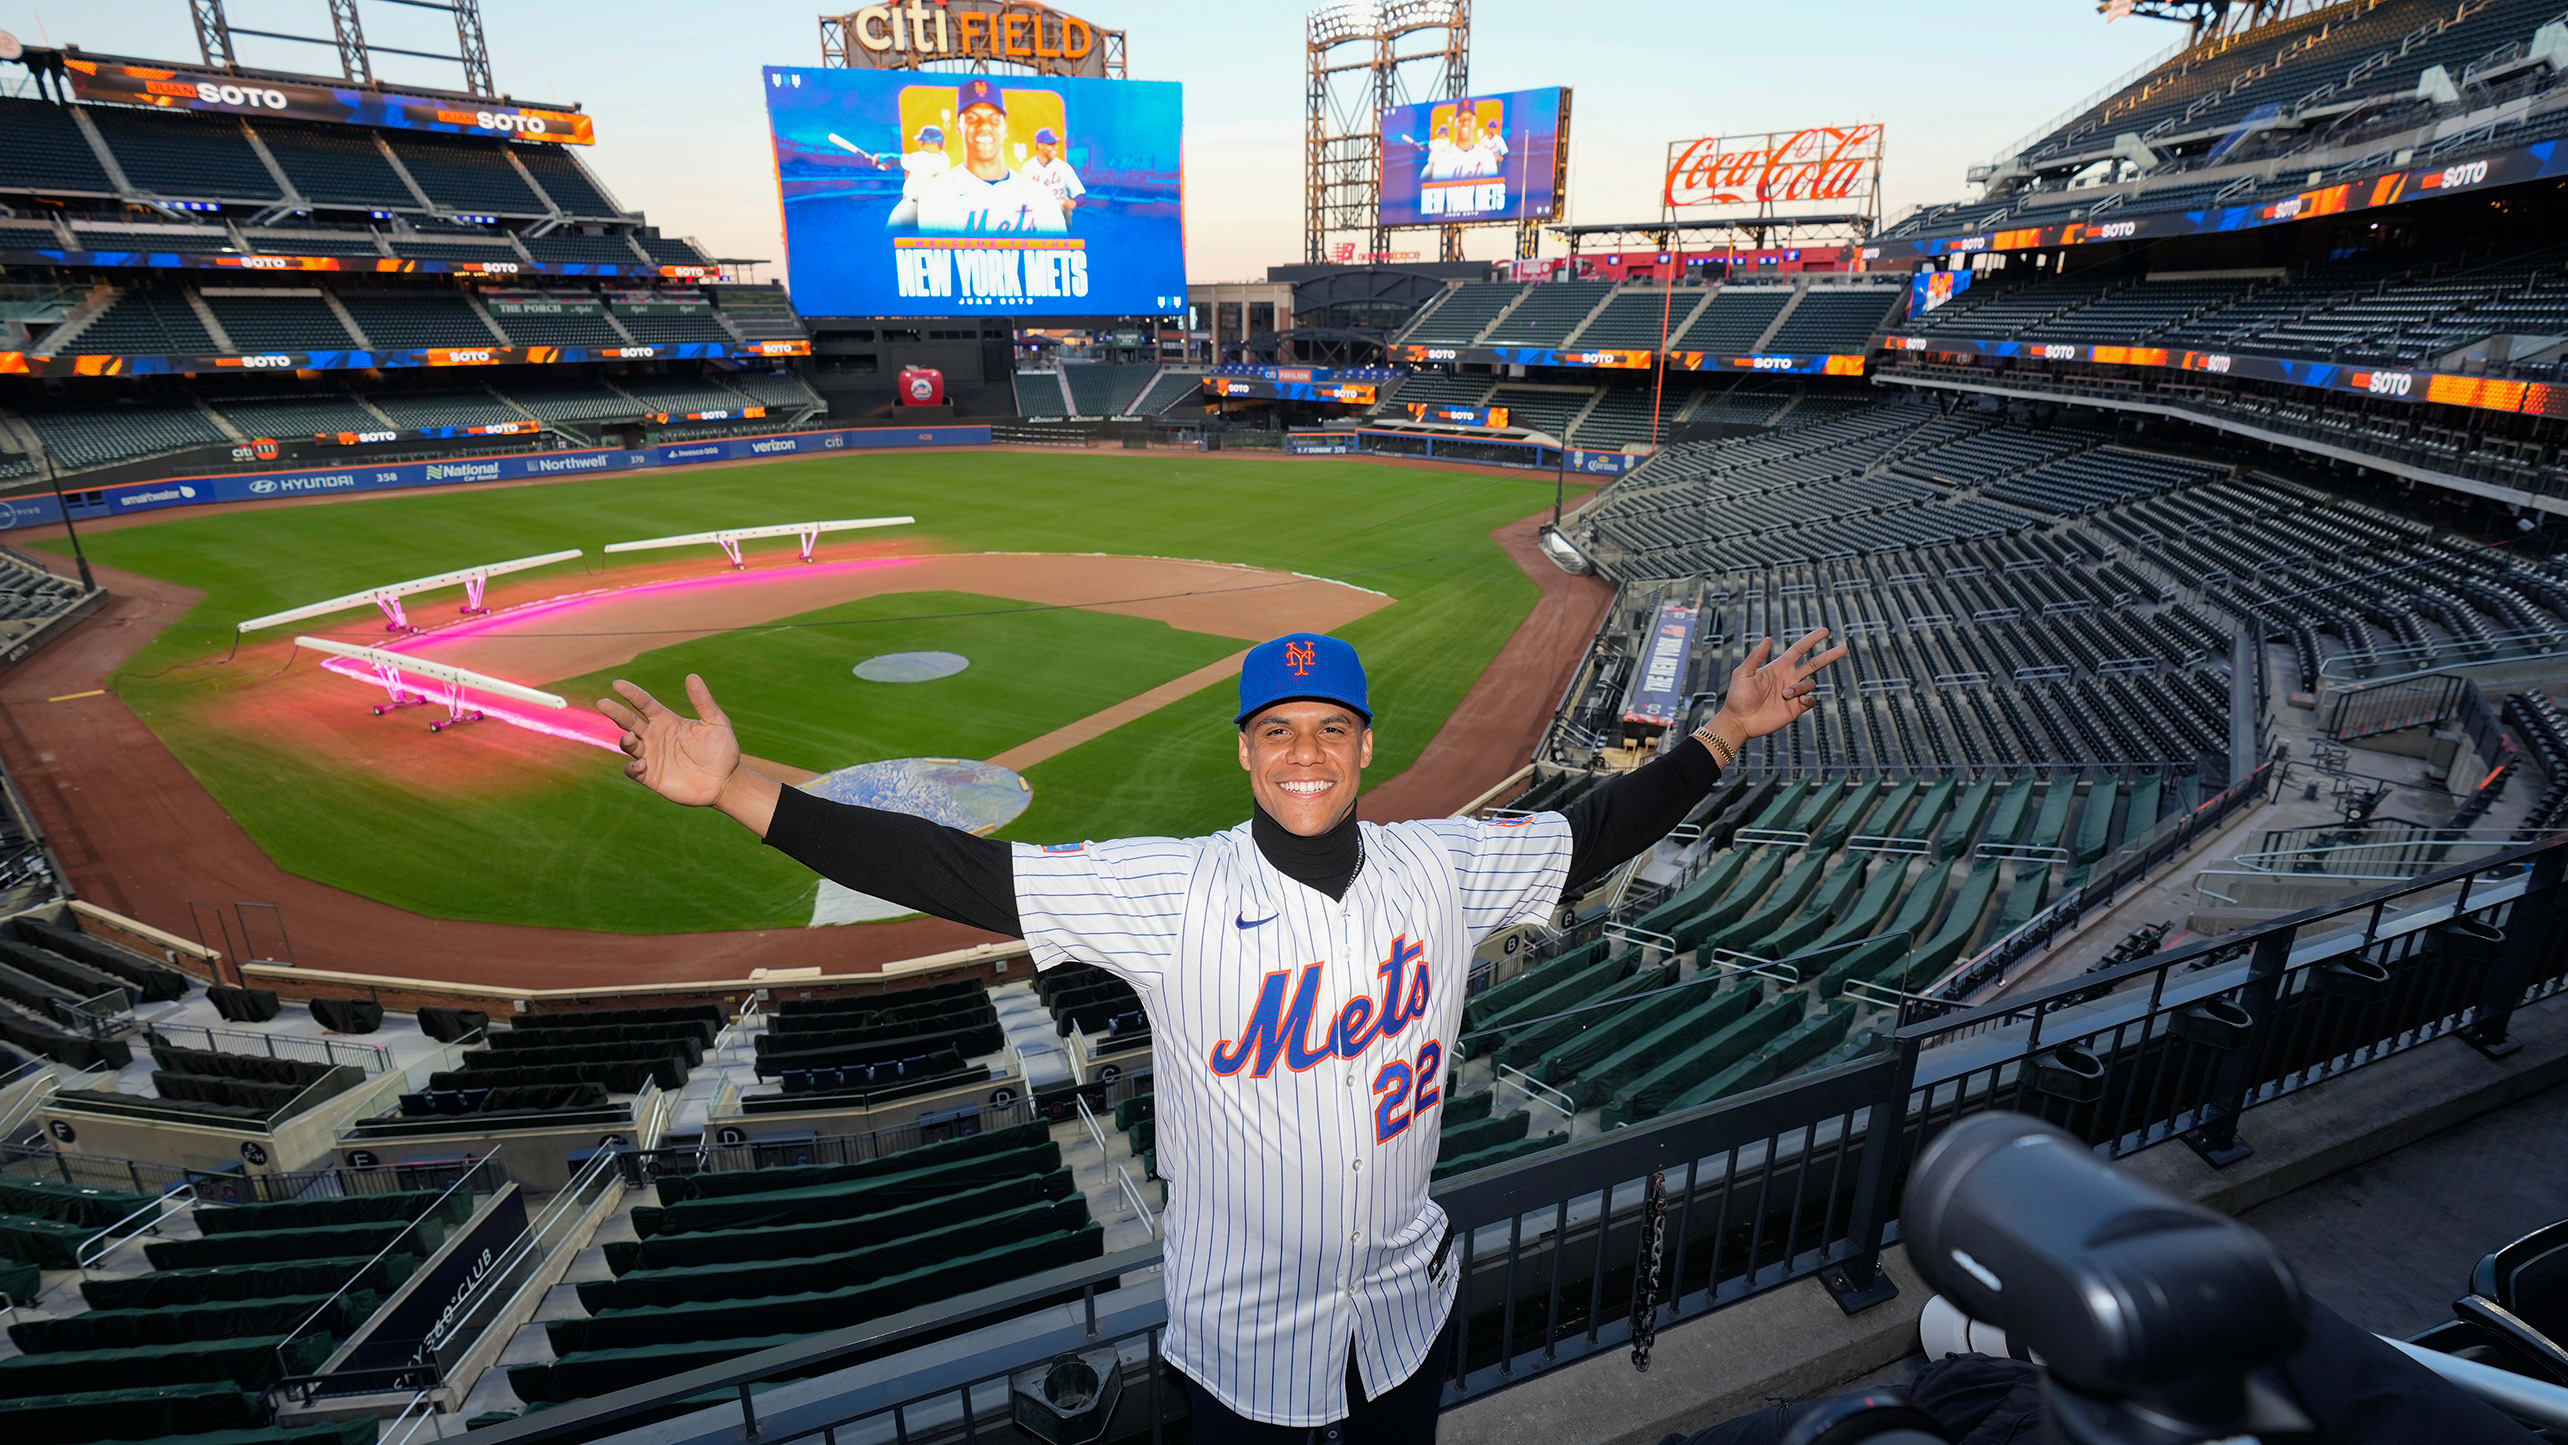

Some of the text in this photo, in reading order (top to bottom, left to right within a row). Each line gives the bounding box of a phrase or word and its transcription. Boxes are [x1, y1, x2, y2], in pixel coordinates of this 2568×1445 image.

[856, 0, 1093, 59] citi FIELD
[196, 82, 288, 110] SOTO
[476, 110, 546, 134] SOTO
[1664, 123, 1884, 207] Coca-Cola
[2440, 159, 2489, 189] SOTO
[2273, 198, 2303, 220] SOTO
[2101, 220, 2136, 239] SOTO
[1961, 236, 1985, 252] SOTO
[1861, 247, 1880, 260] SOTO
[240, 256, 286, 268] SOTO
[482, 262, 518, 273] SOTO
[895, 248, 1089, 298] NEW YORK METS
[499, 304, 562, 313] THE PORCH
[620, 347, 654, 357] SOTO
[1905, 338, 1928, 351] SOTO
[2044, 344, 2075, 360] SOTO
[241, 355, 291, 367] SOTO
[449, 351, 490, 362] SOTO
[1427, 349, 1456, 360] SOTO
[1581, 353, 1615, 364] SOTO
[1753, 358, 1793, 369] SOTO
[2207, 354, 2232, 373] SOTO
[1279, 371, 1311, 381] PAVILION
[2368, 370, 2412, 396] SOTO
[1228, 383, 1250, 393] SOTO
[1333, 389, 1358, 399] SOTO
[1450, 411, 1475, 420] SOTO
[485, 423, 520, 434] SOTO
[358, 431, 397, 443] SOTO
[825, 436, 844, 448] citi
[752, 439, 797, 453] verizon
[443, 462, 499, 478] National
[539, 455, 607, 471] Northwell
[1588, 460, 1619, 472] Corona
[280, 475, 354, 491] HYUNDAI
[376, 472, 398, 483] 358
[120, 490, 180, 506] smartwater
[1564, 912, 1573, 928] B
[1507, 938, 1517, 954] B
[1210, 933, 1431, 1079] Mets
[995, 1091, 1011, 1107] D
[1372, 1039, 1442, 1146] 22
[53, 1123, 68, 1138] F
[723, 1129, 739, 1147] D
